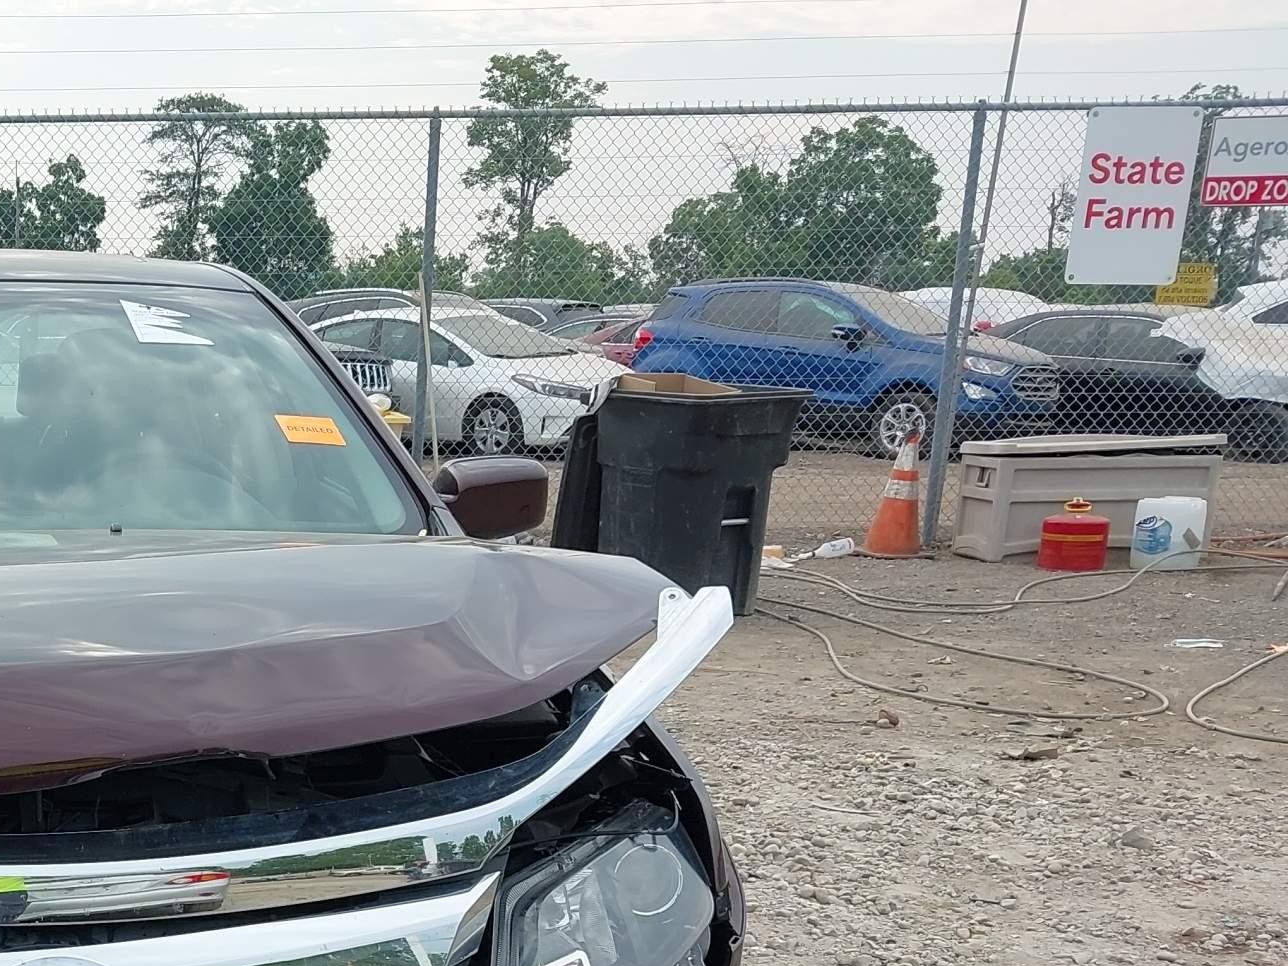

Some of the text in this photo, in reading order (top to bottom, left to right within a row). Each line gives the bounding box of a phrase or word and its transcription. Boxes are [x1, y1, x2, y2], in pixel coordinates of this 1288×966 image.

[1214, 137, 1288, 162] Agero
[1088, 152, 1185, 185] State
[1205, 179, 1288, 202] DROP ZO
[1083, 198, 1175, 229] Farm
[287, 425, 334, 434] DETAILED
